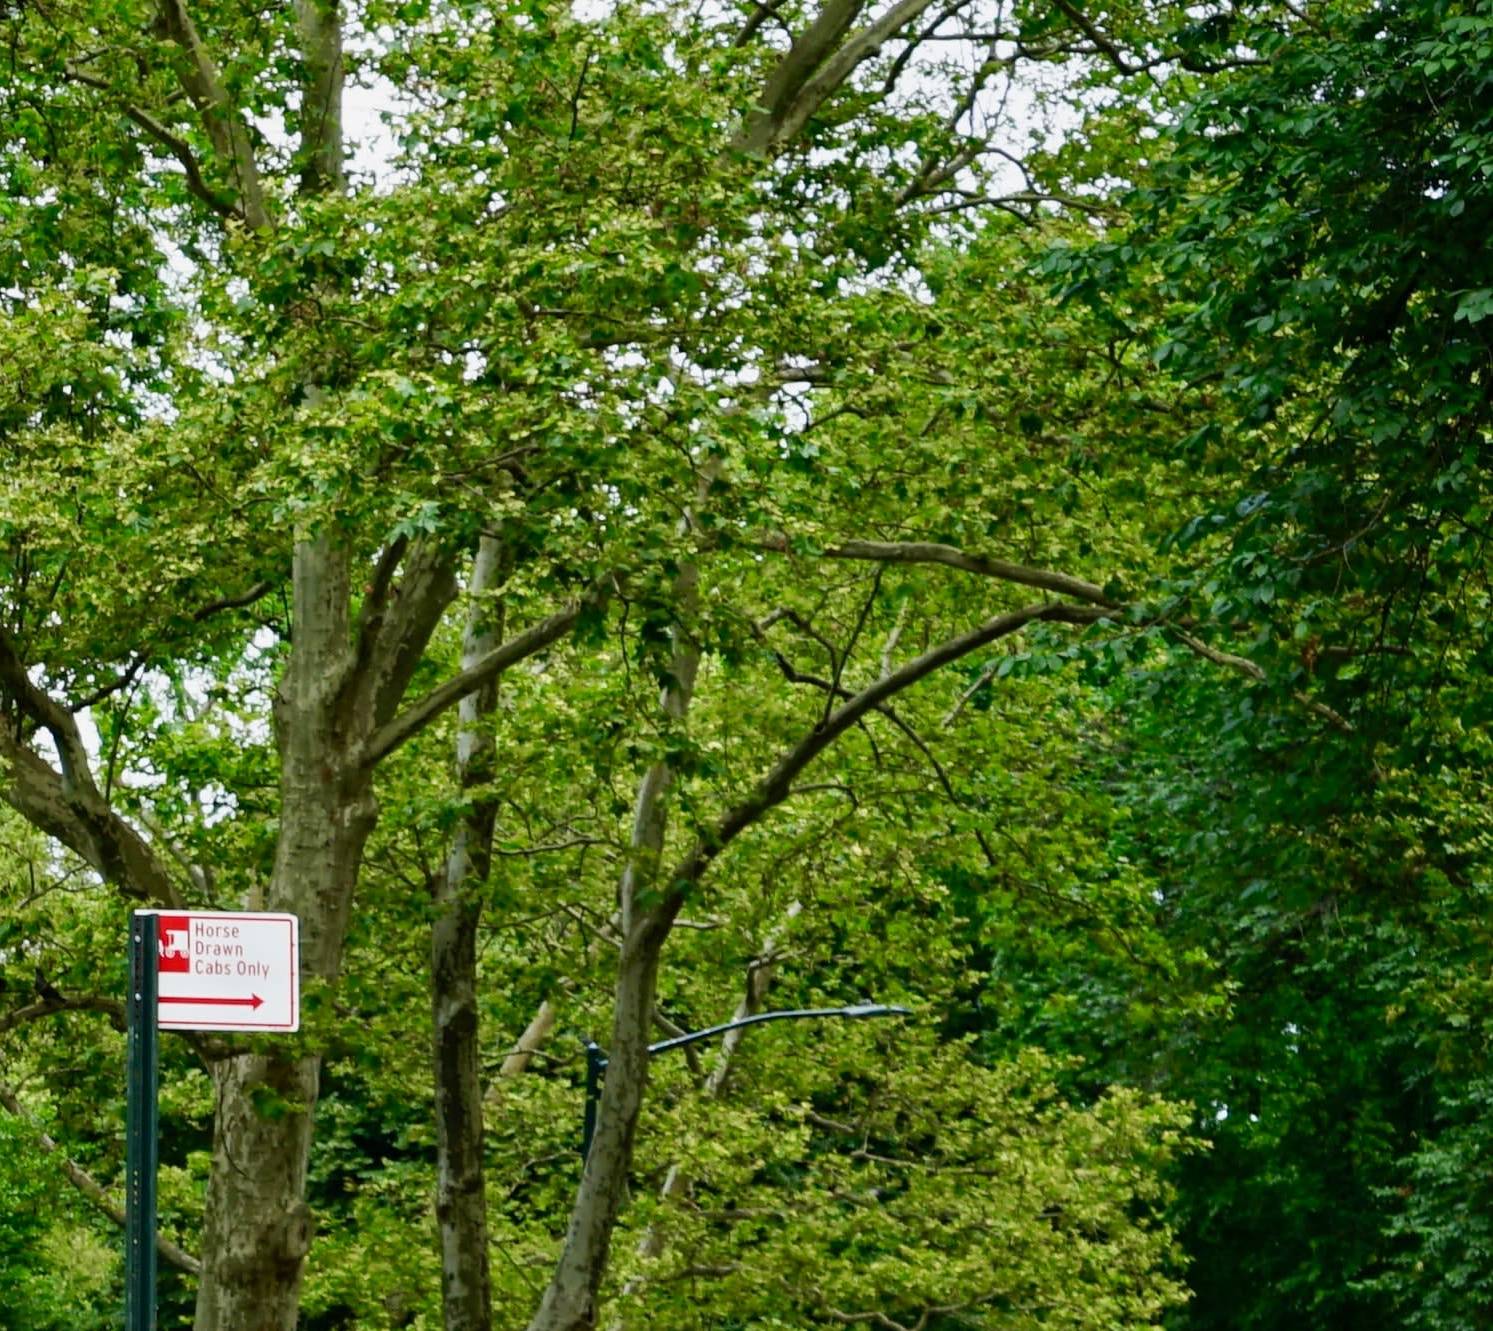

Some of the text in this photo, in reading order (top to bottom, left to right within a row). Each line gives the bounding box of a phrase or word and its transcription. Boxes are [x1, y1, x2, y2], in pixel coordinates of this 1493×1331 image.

[195, 921, 240, 938] Horse
[195, 940, 244, 957] Drawn
[195, 959, 270, 980] Cabs Only
